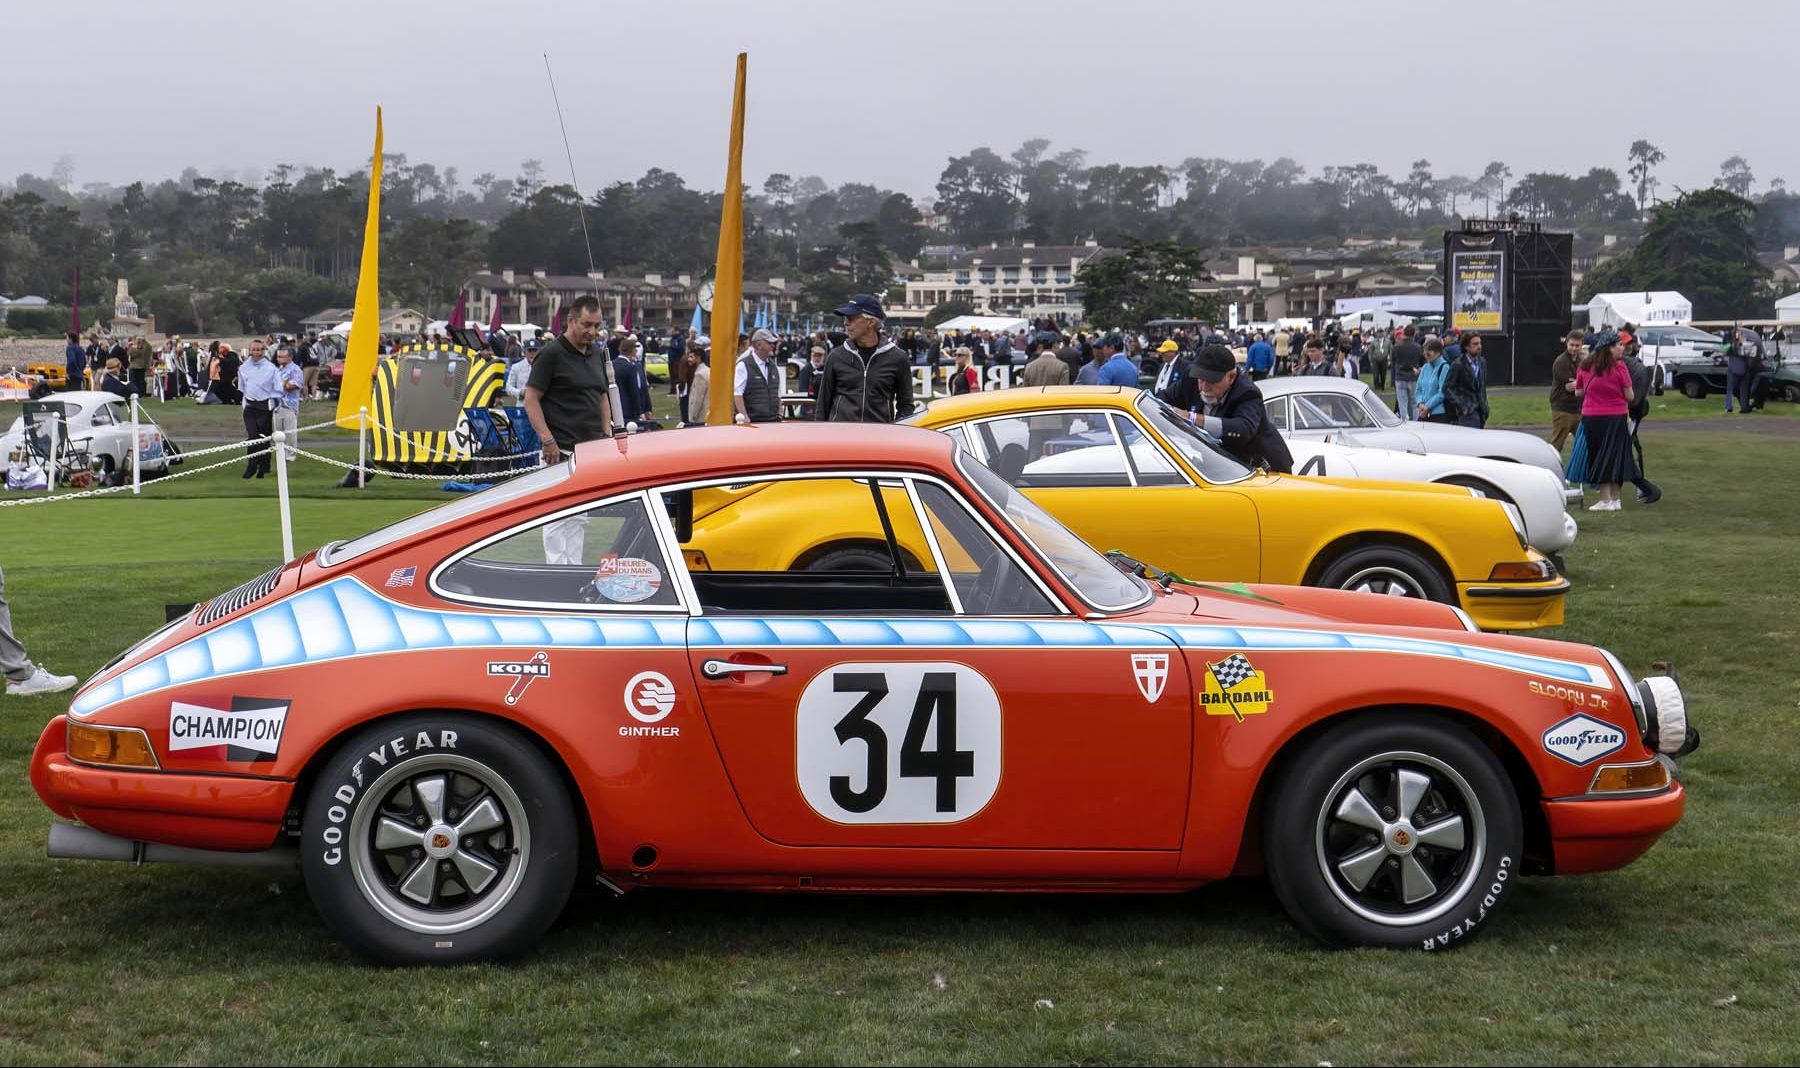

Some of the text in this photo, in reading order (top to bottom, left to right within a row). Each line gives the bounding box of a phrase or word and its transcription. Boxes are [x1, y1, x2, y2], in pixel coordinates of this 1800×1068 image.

[600, 558, 617, 571] 24
[491, 664, 547, 675] KONI
[1201, 691, 1273, 704] BARDAHL
[172, 715, 281, 740] CHAMPION
[618, 726, 680, 737] GINTHER
[829, 672, 975, 813] 34
